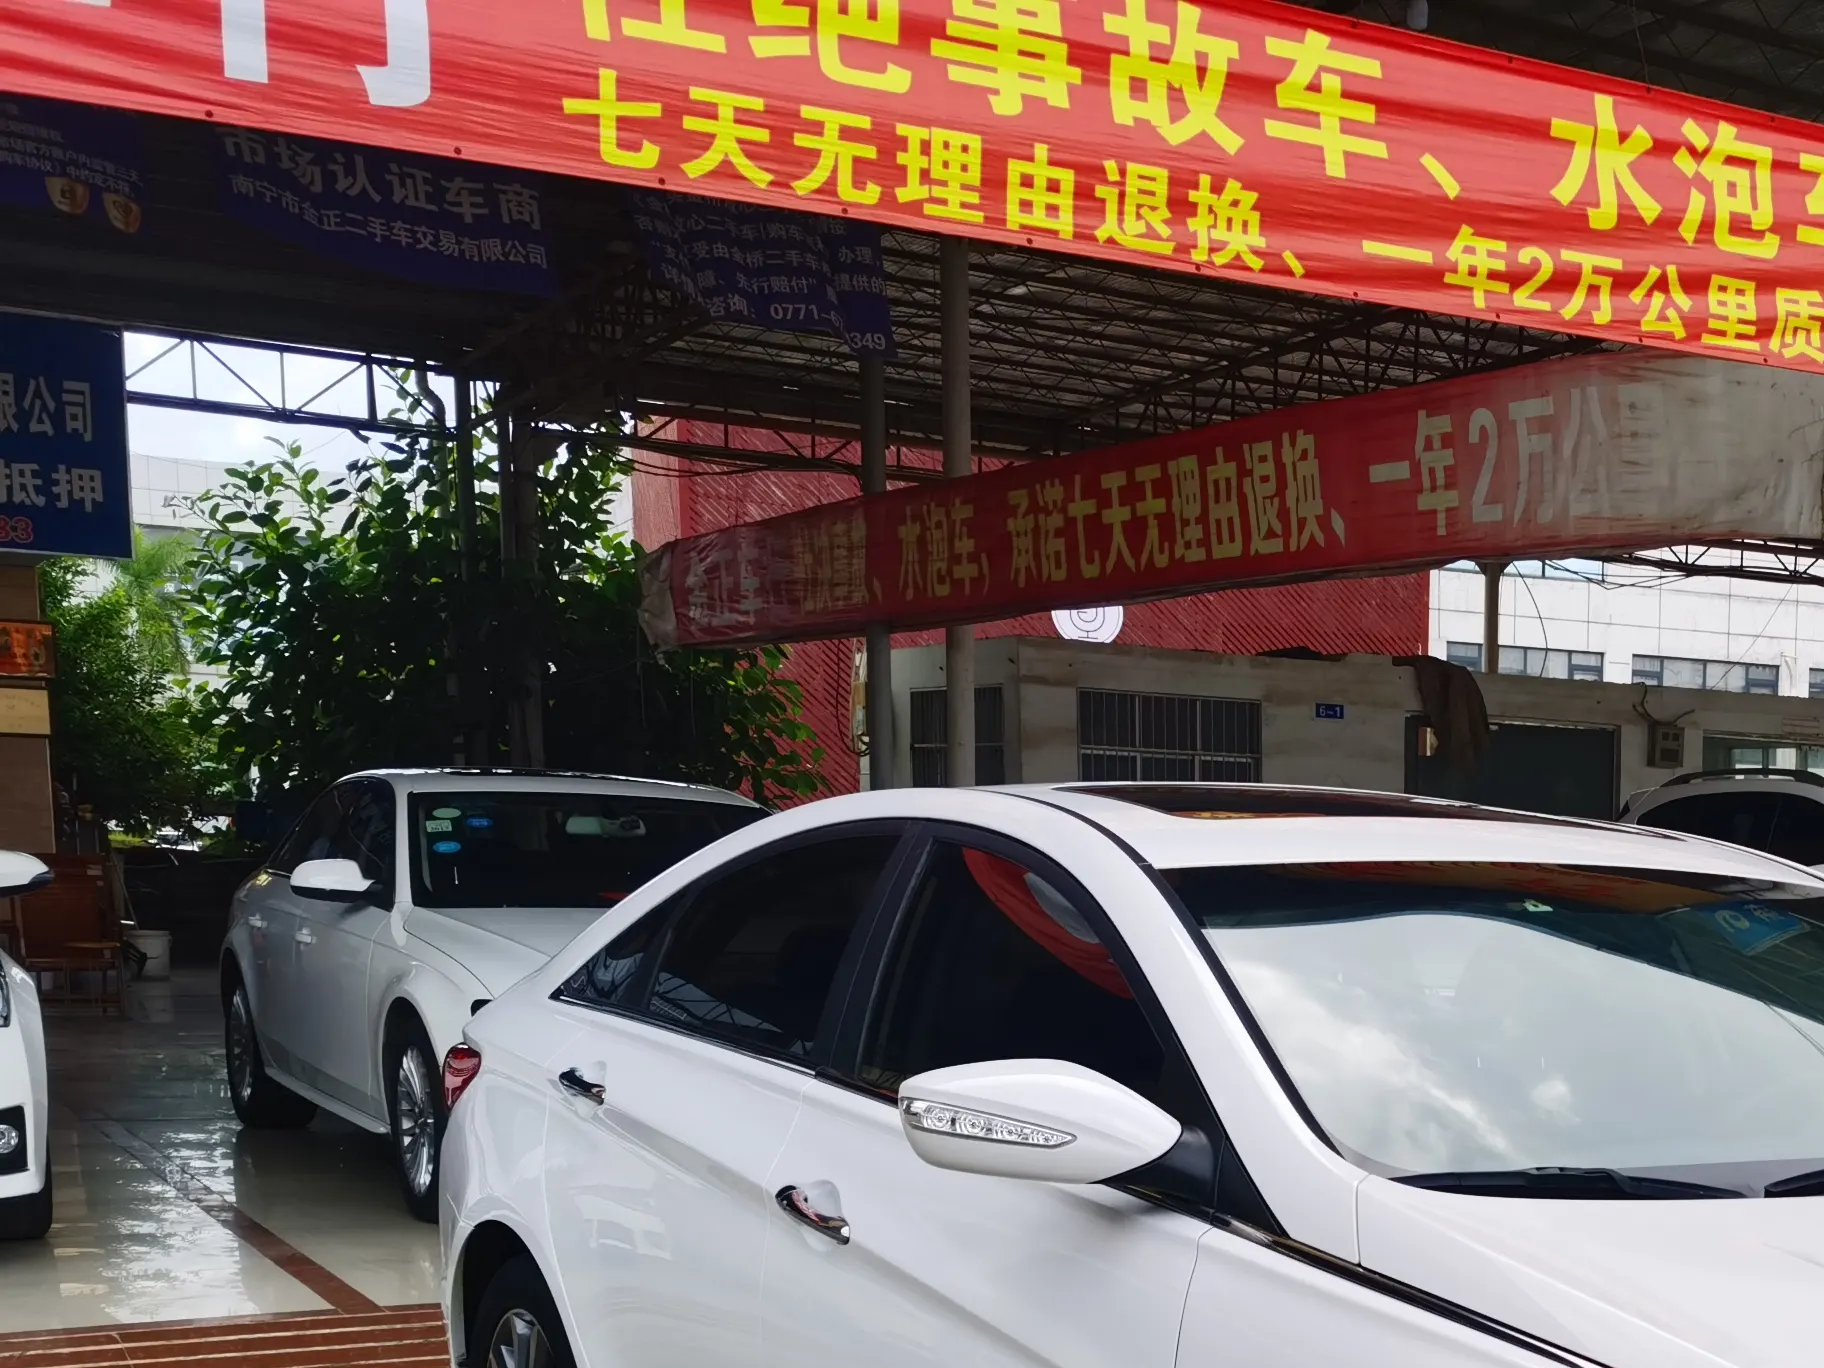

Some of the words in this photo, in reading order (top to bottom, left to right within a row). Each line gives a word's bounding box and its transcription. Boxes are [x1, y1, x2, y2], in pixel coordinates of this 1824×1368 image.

[215, 126, 543, 231] 市场认证车商
[228, 172, 548, 269] 南宁市金正二手车交易有限公司
[0, 457, 104, 513] 抵押
[1319, 705, 1341, 718] 6-1
